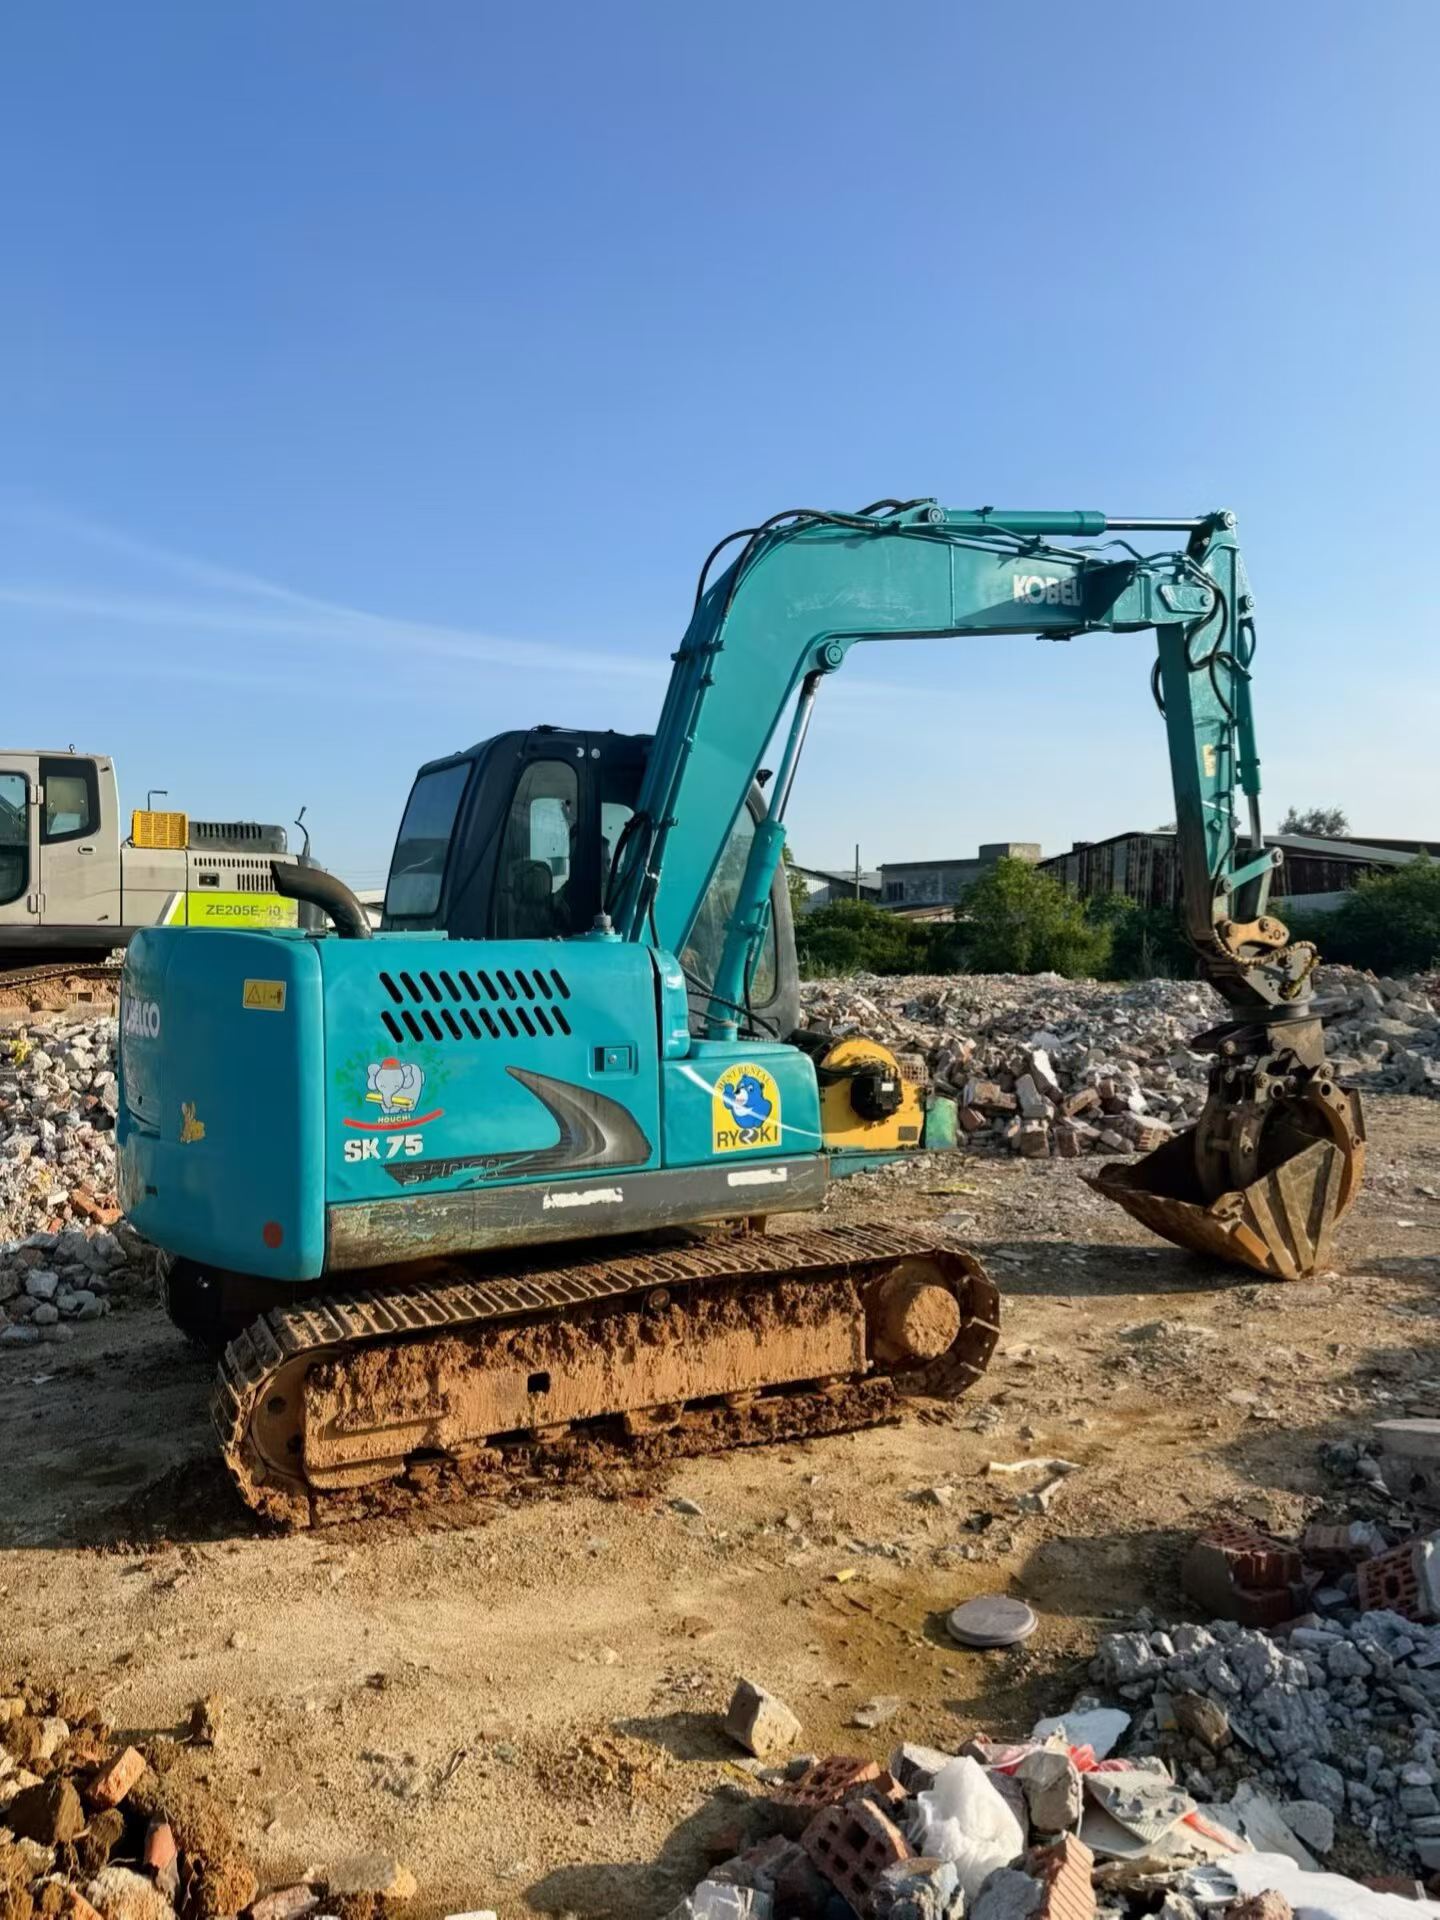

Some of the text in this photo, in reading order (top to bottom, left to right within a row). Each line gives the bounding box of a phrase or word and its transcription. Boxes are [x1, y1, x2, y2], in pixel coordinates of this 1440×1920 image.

[1013, 575, 1082, 606] KOBEL
[344, 1134, 423, 1162] SK 75
